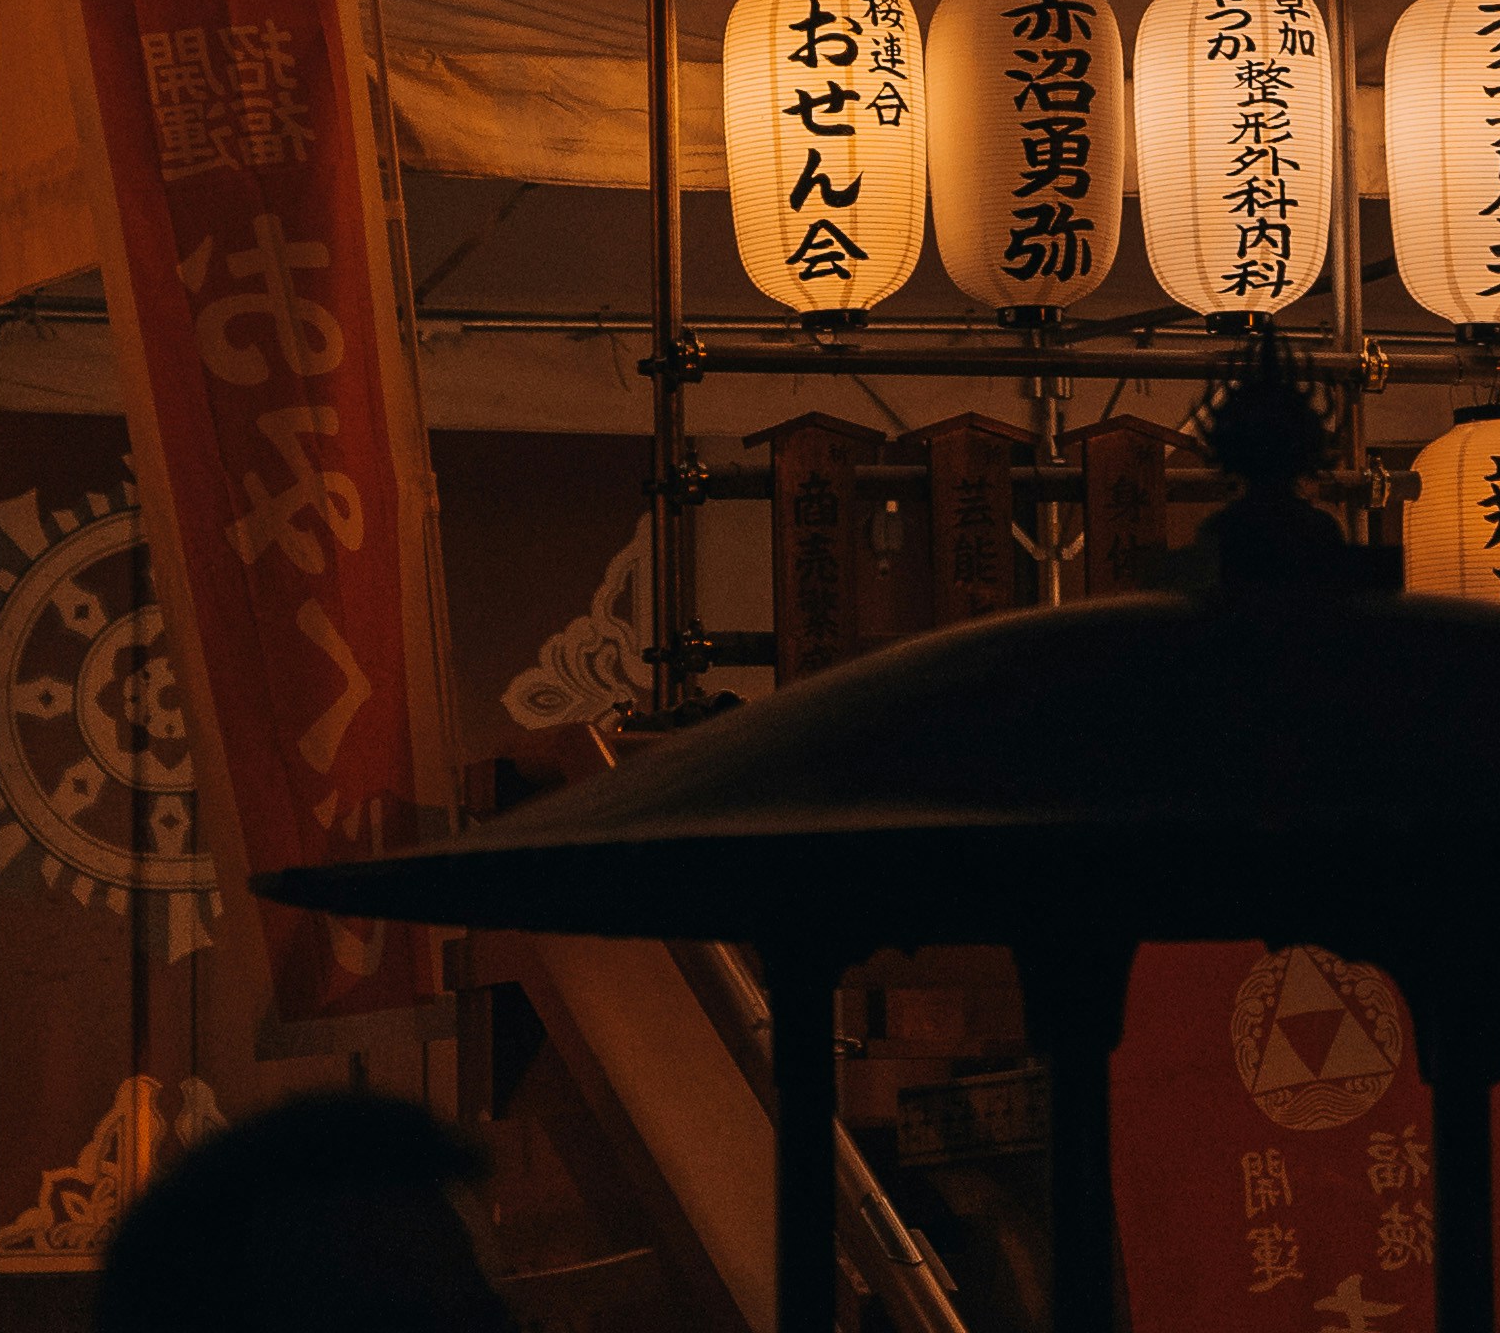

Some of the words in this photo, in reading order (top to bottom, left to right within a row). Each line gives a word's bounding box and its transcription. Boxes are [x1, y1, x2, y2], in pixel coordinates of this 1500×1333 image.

[1219, 58, 1301, 300] 整形外科内科
